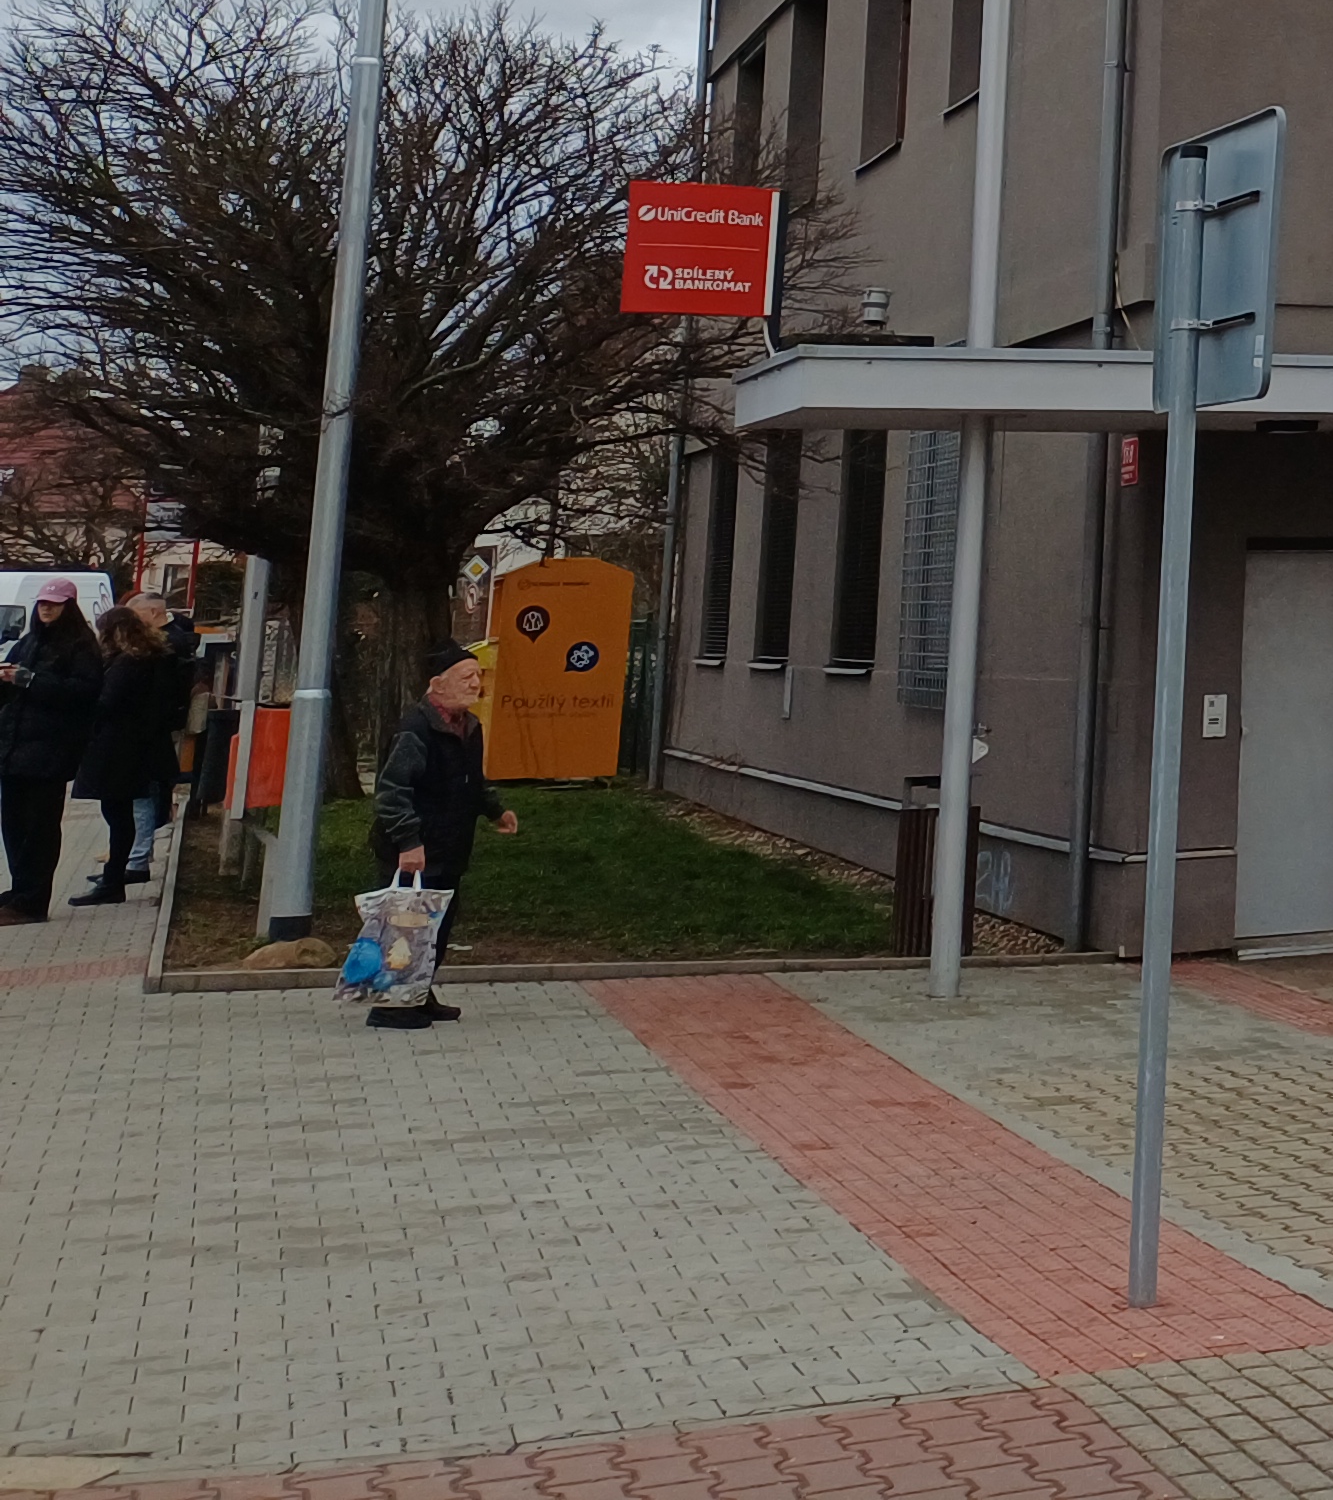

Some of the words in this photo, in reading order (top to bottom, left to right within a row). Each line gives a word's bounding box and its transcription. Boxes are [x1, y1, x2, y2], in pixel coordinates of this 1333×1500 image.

[657, 206, 725, 223] UniCredit
[728, 209, 764, 227] Bank
[675, 266, 735, 281] SDÍLENÝ
[675, 280, 752, 293] BANKOMAT
[501, 693, 566, 712] Použitý
[572, 693, 615, 709] textil
